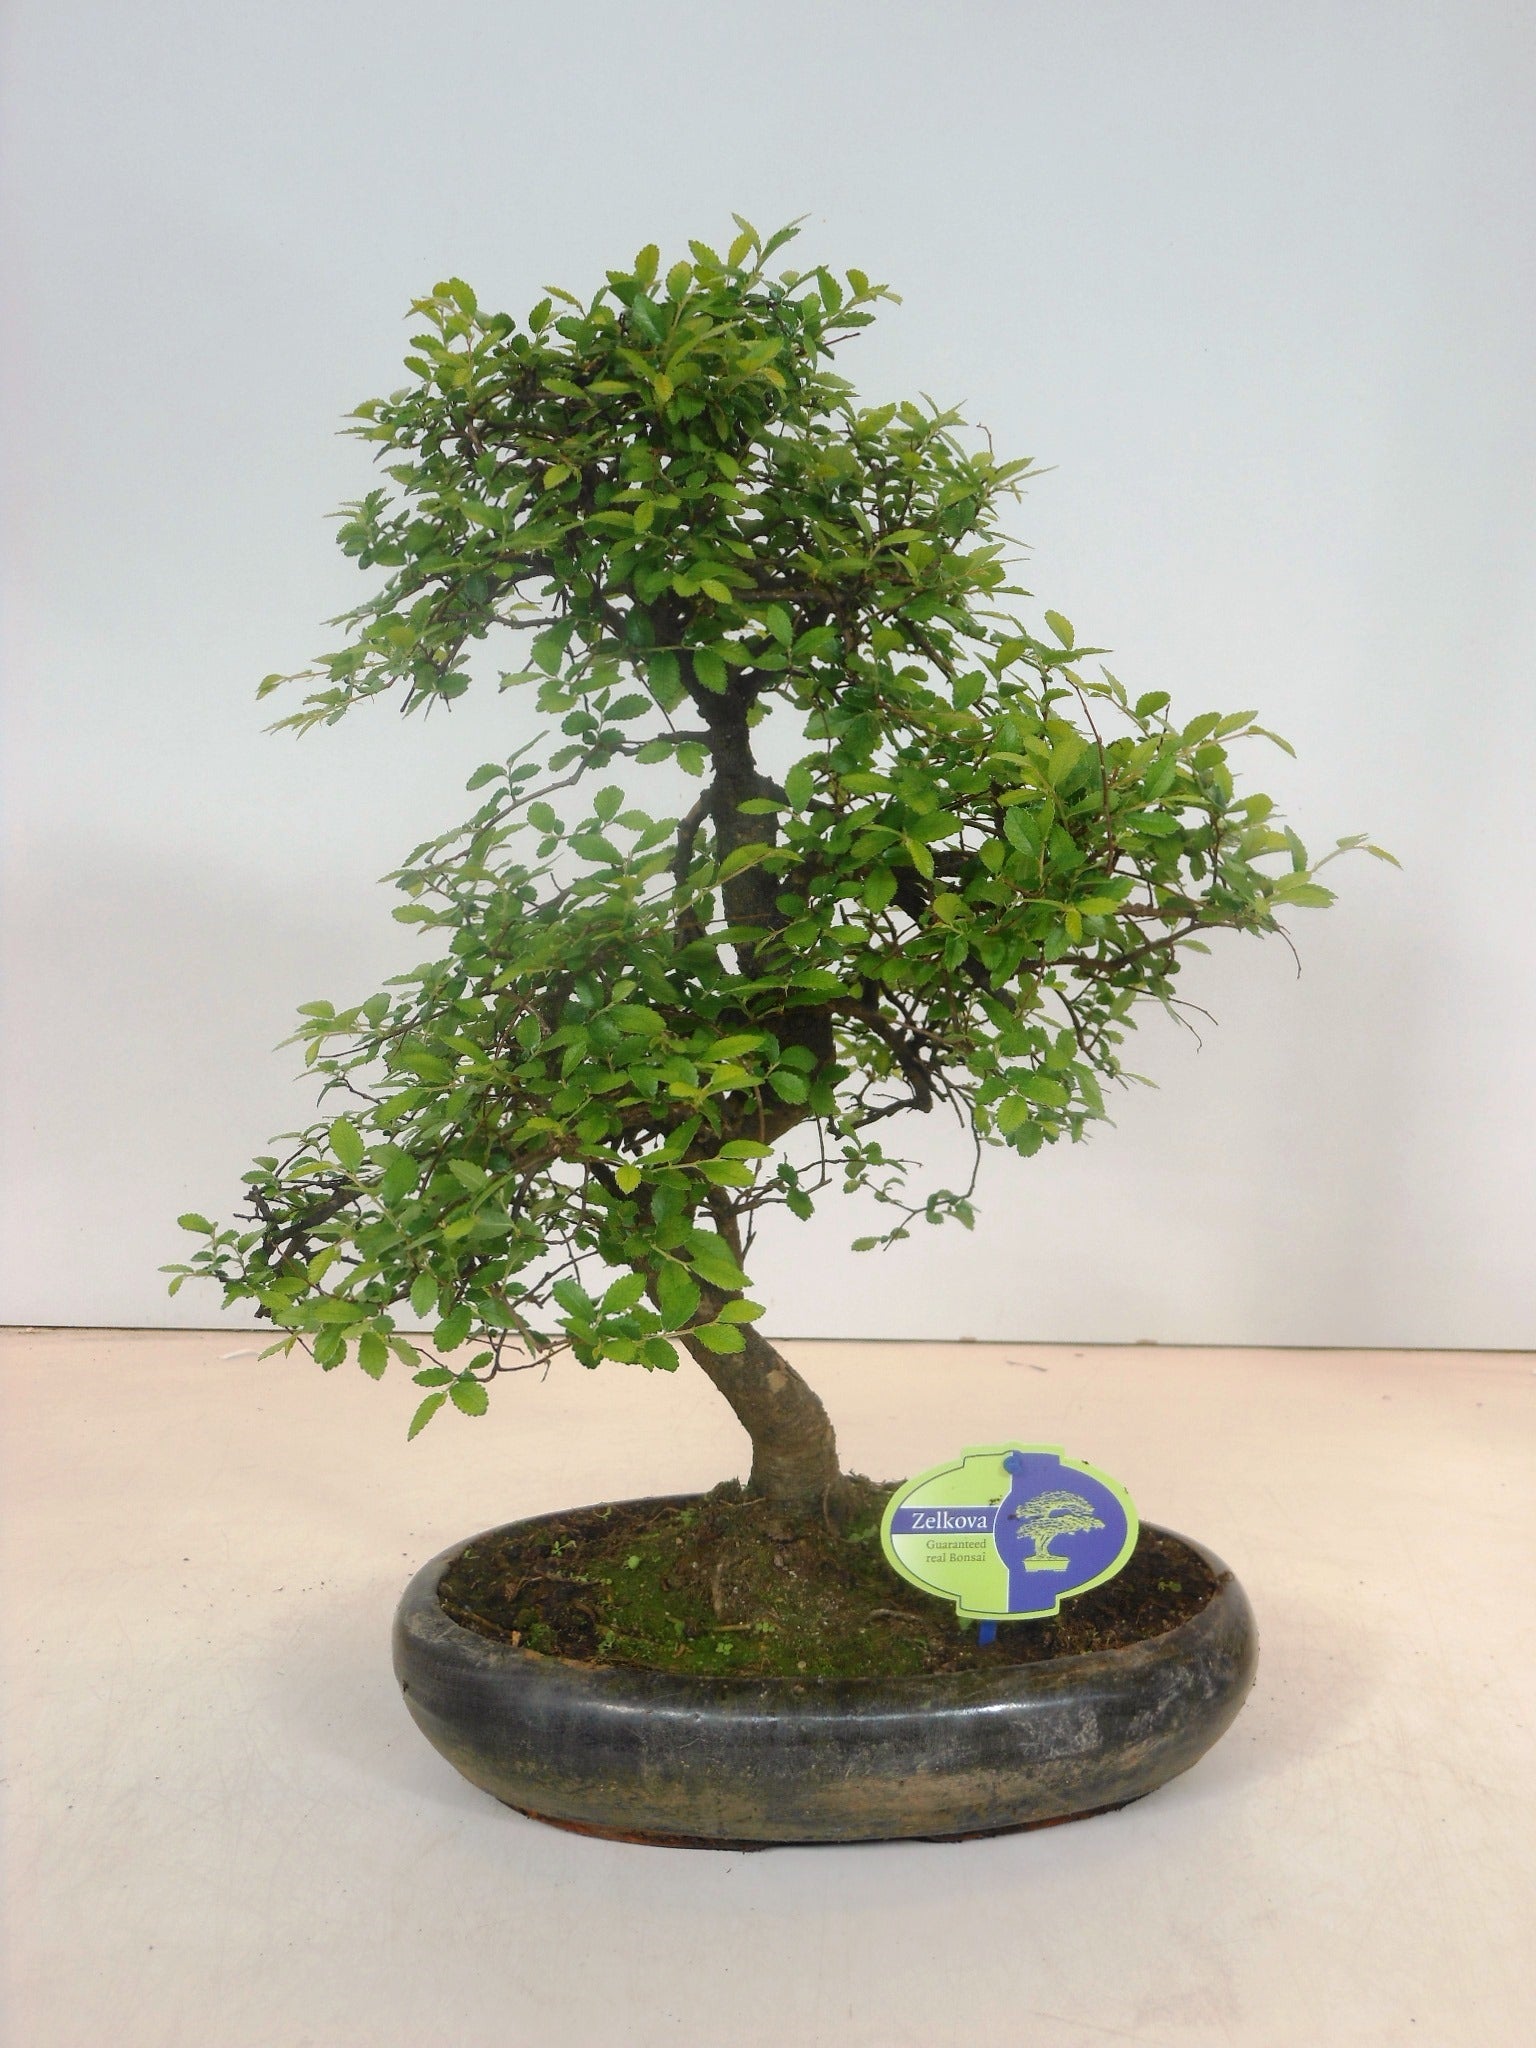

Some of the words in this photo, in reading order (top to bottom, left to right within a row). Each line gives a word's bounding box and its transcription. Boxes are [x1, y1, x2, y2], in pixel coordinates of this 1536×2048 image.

[911, 1511, 988, 1529] Zelkova
[926, 1539, 987, 1550] Guaranteed
[926, 1553, 946, 1562] real
[949, 1552, 986, 1562] Bonsai
